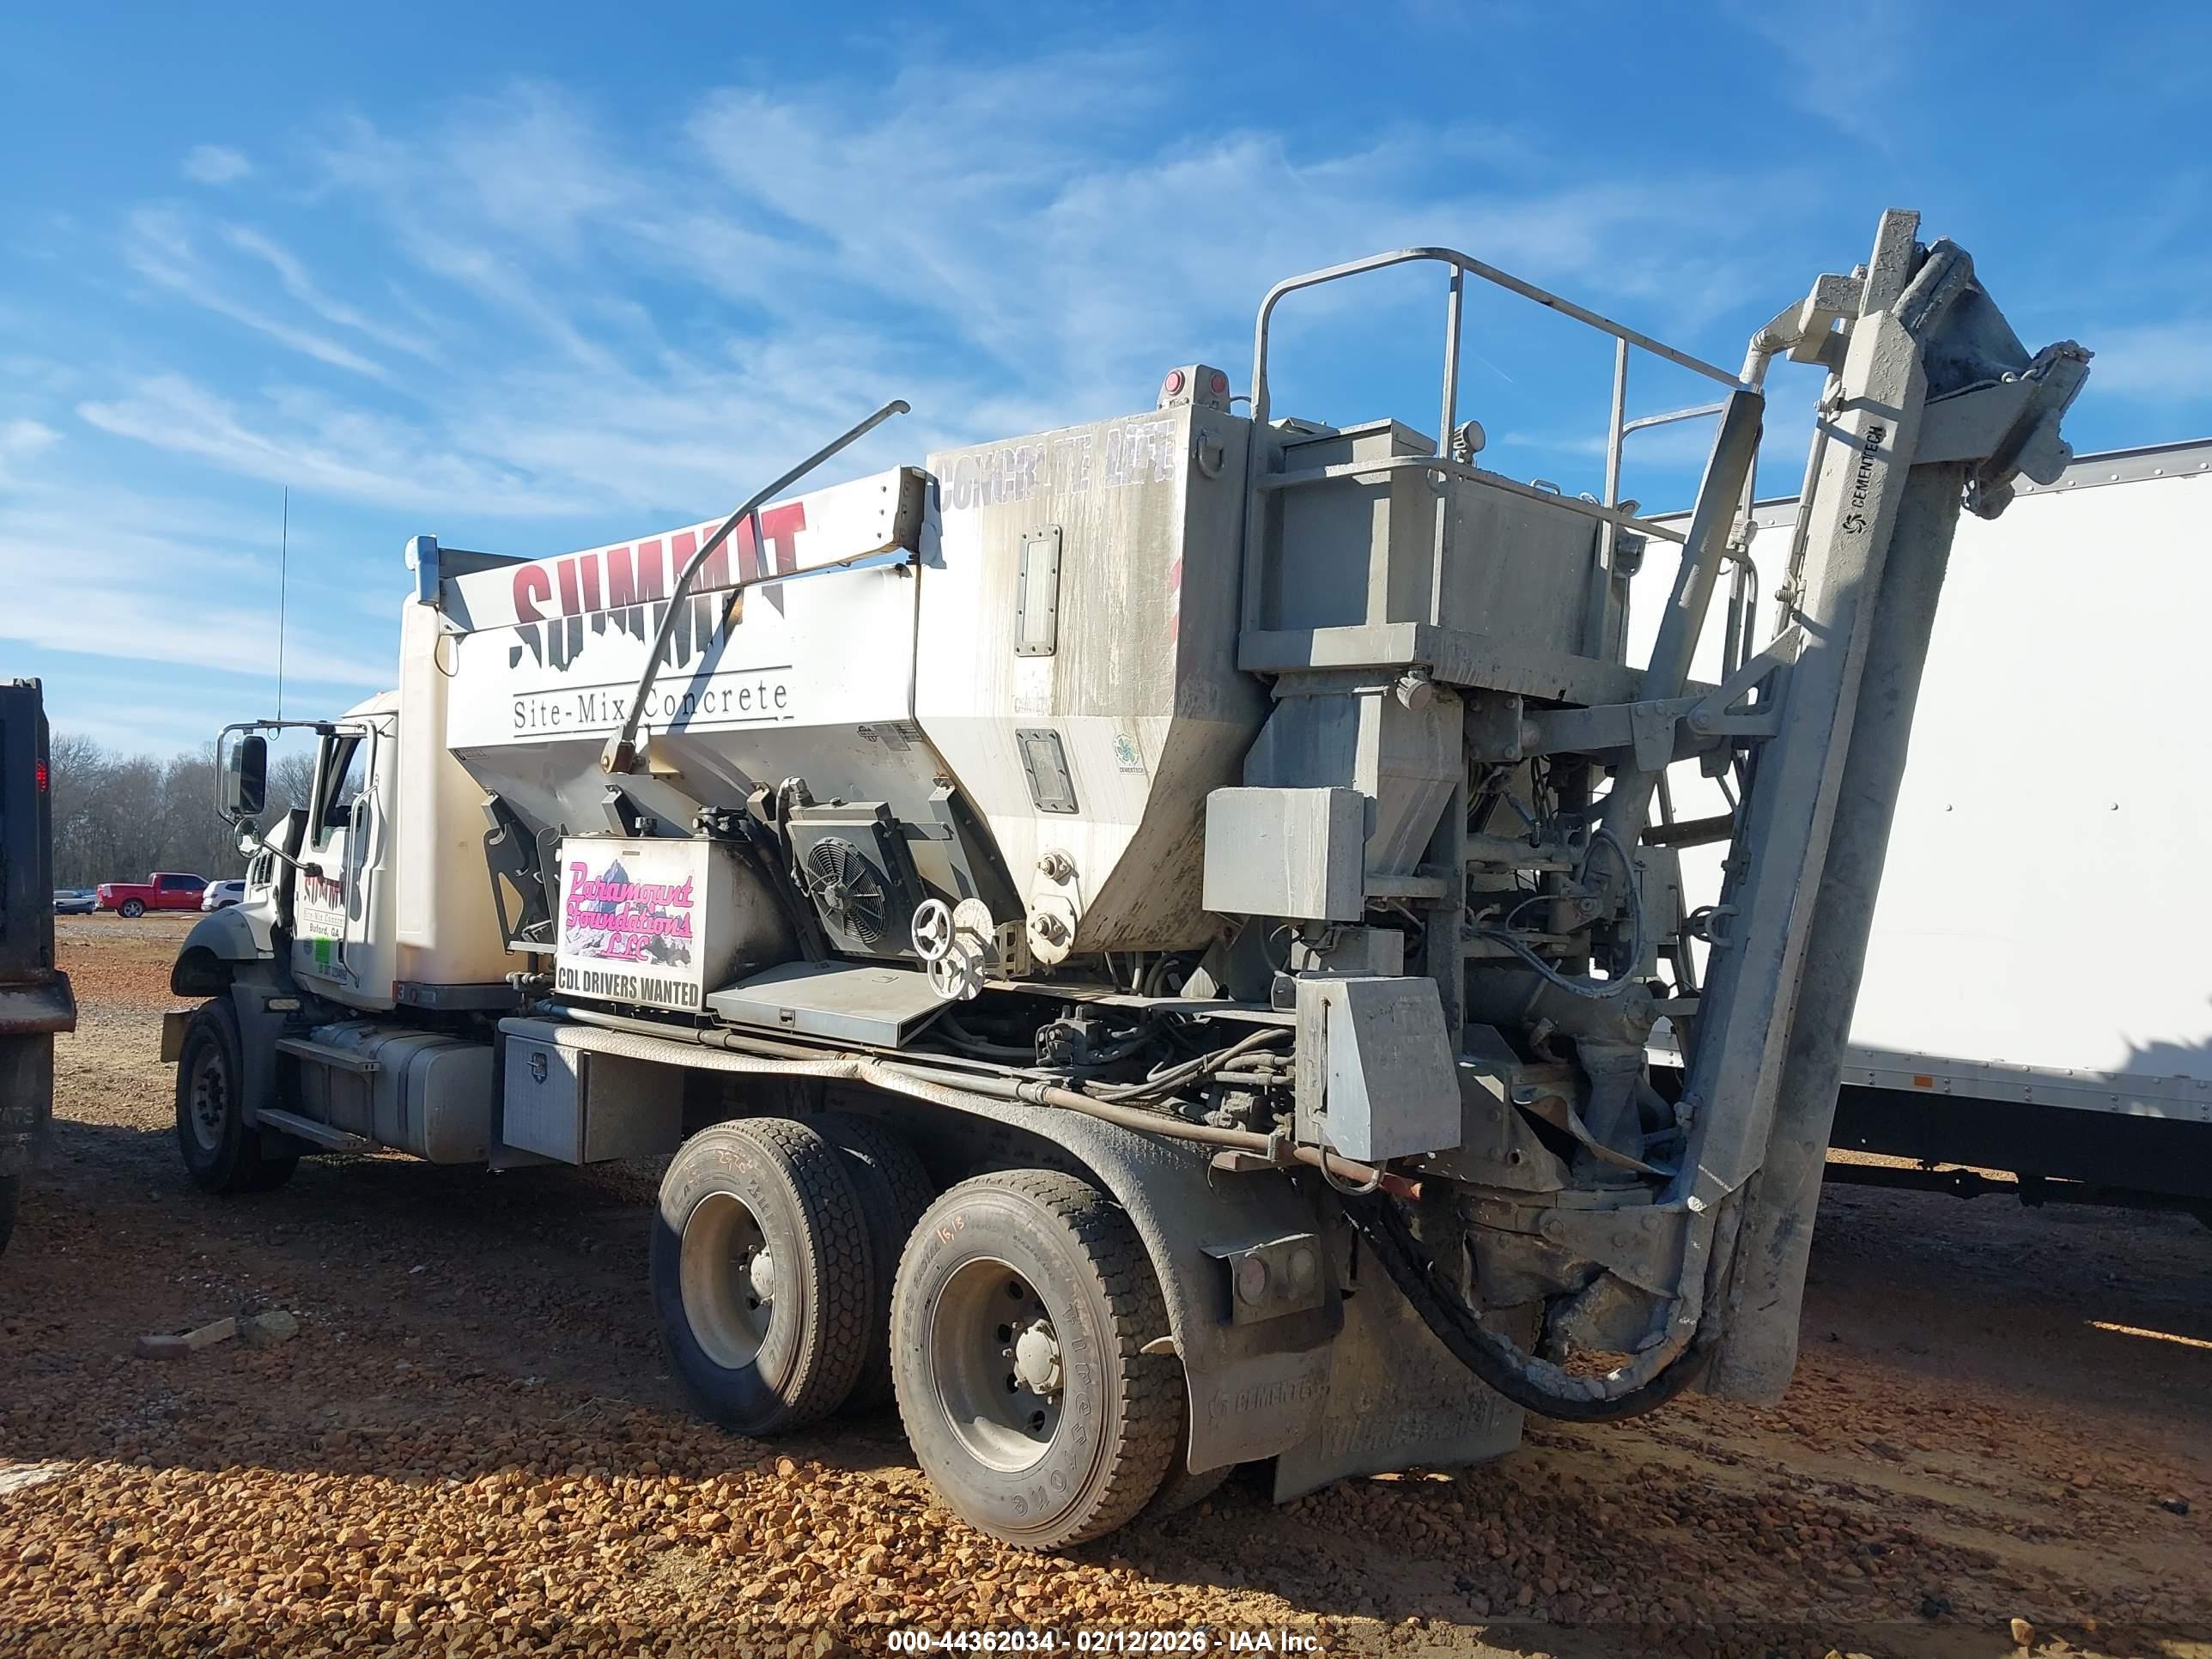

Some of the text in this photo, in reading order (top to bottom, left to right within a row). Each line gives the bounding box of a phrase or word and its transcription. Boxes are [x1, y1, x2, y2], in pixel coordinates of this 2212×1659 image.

[1851, 425, 1883, 508] CEMENTECH
[509, 501, 806, 673] SUMMIT
[514, 679, 788, 730] Site-Mix Concrete
[570, 861, 694, 908] Paramount
[566, 894, 693, 939] Foundations
[558, 967, 699, 1006] CDL DRIVERS WANTED
